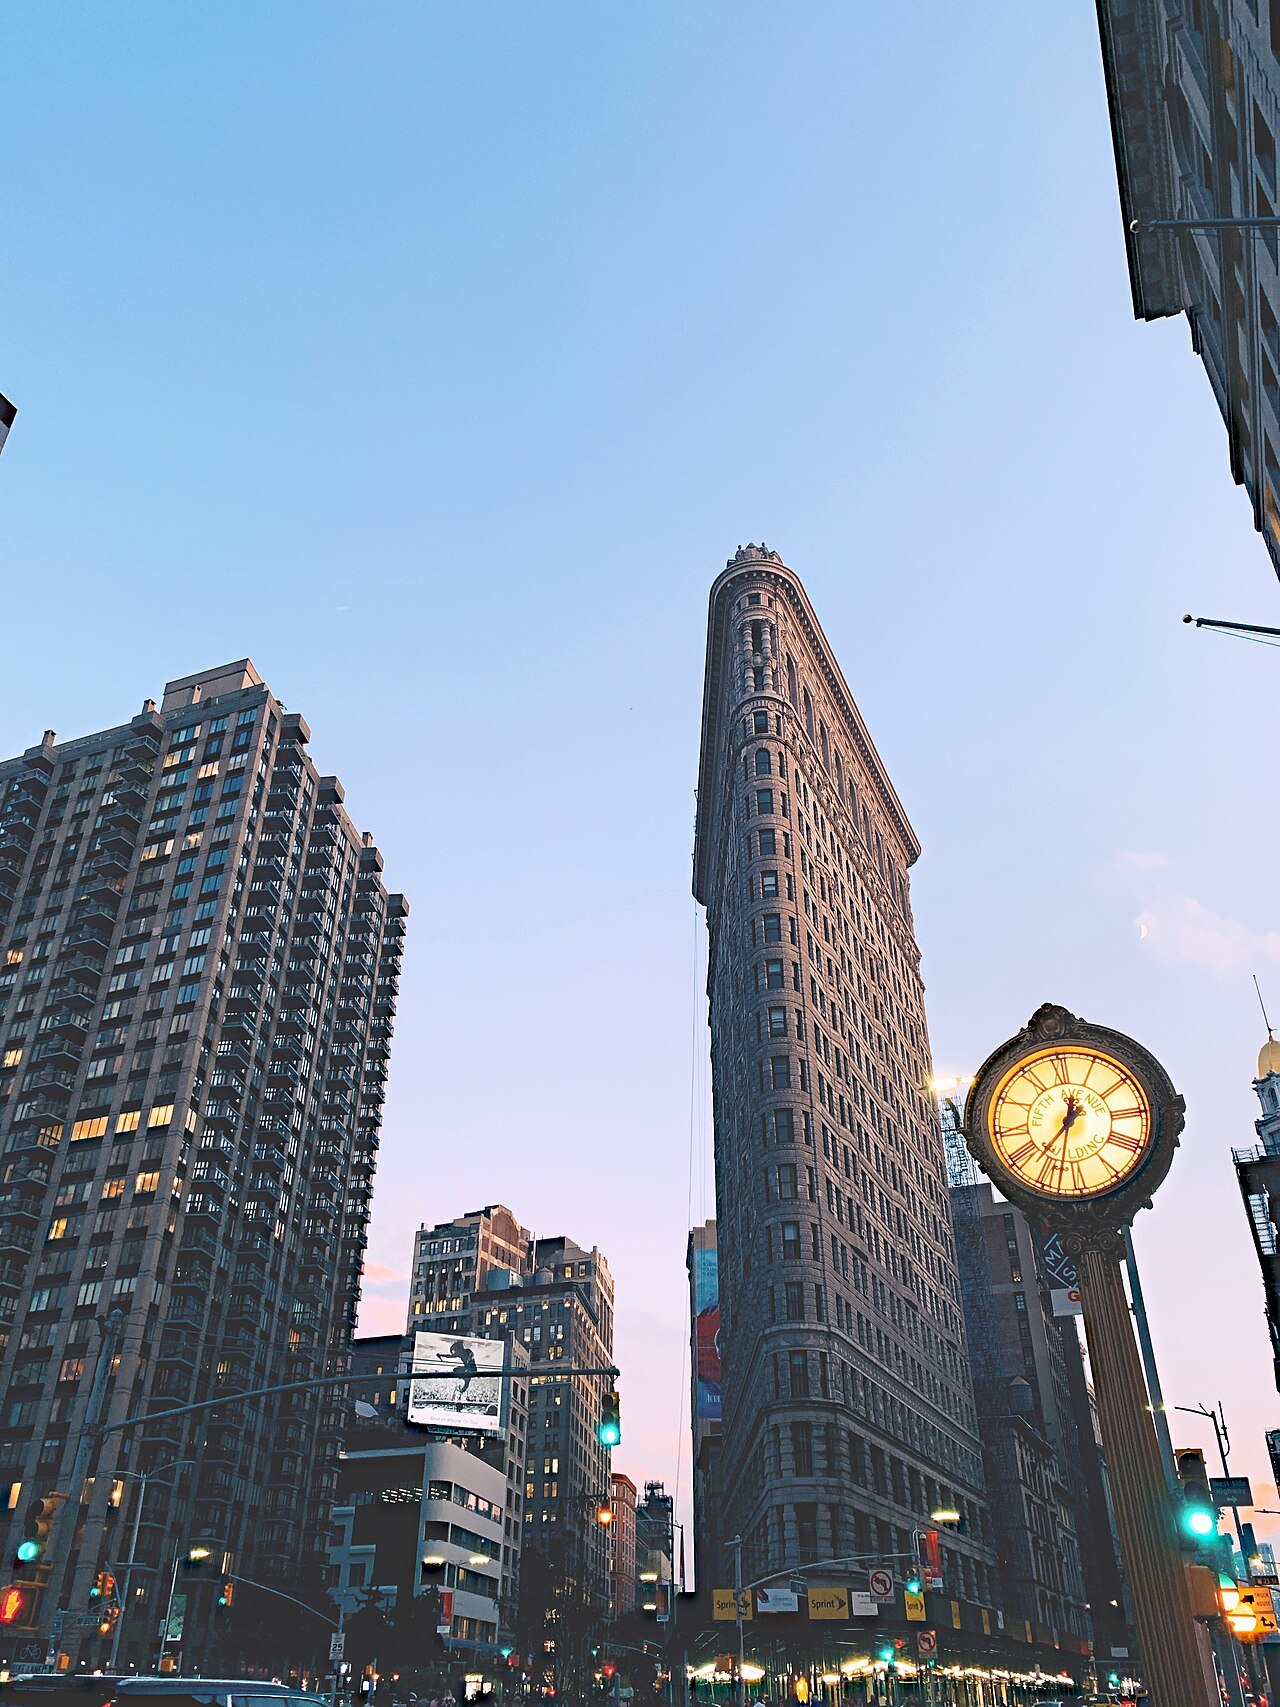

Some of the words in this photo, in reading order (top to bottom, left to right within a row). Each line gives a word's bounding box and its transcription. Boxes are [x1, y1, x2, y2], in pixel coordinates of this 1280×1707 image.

[1032, 1094, 1055, 1127] FIFTH
[1060, 1088, 1106, 1117] AVENUE
[1049, 1134, 1105, 1159] ULDING
[716, 1600, 738, 1610] Sprin
[811, 1599, 835, 1611] Sprint
[906, 1601, 919, 1612] Sprint
[332, 1643, 343, 1652] 25
